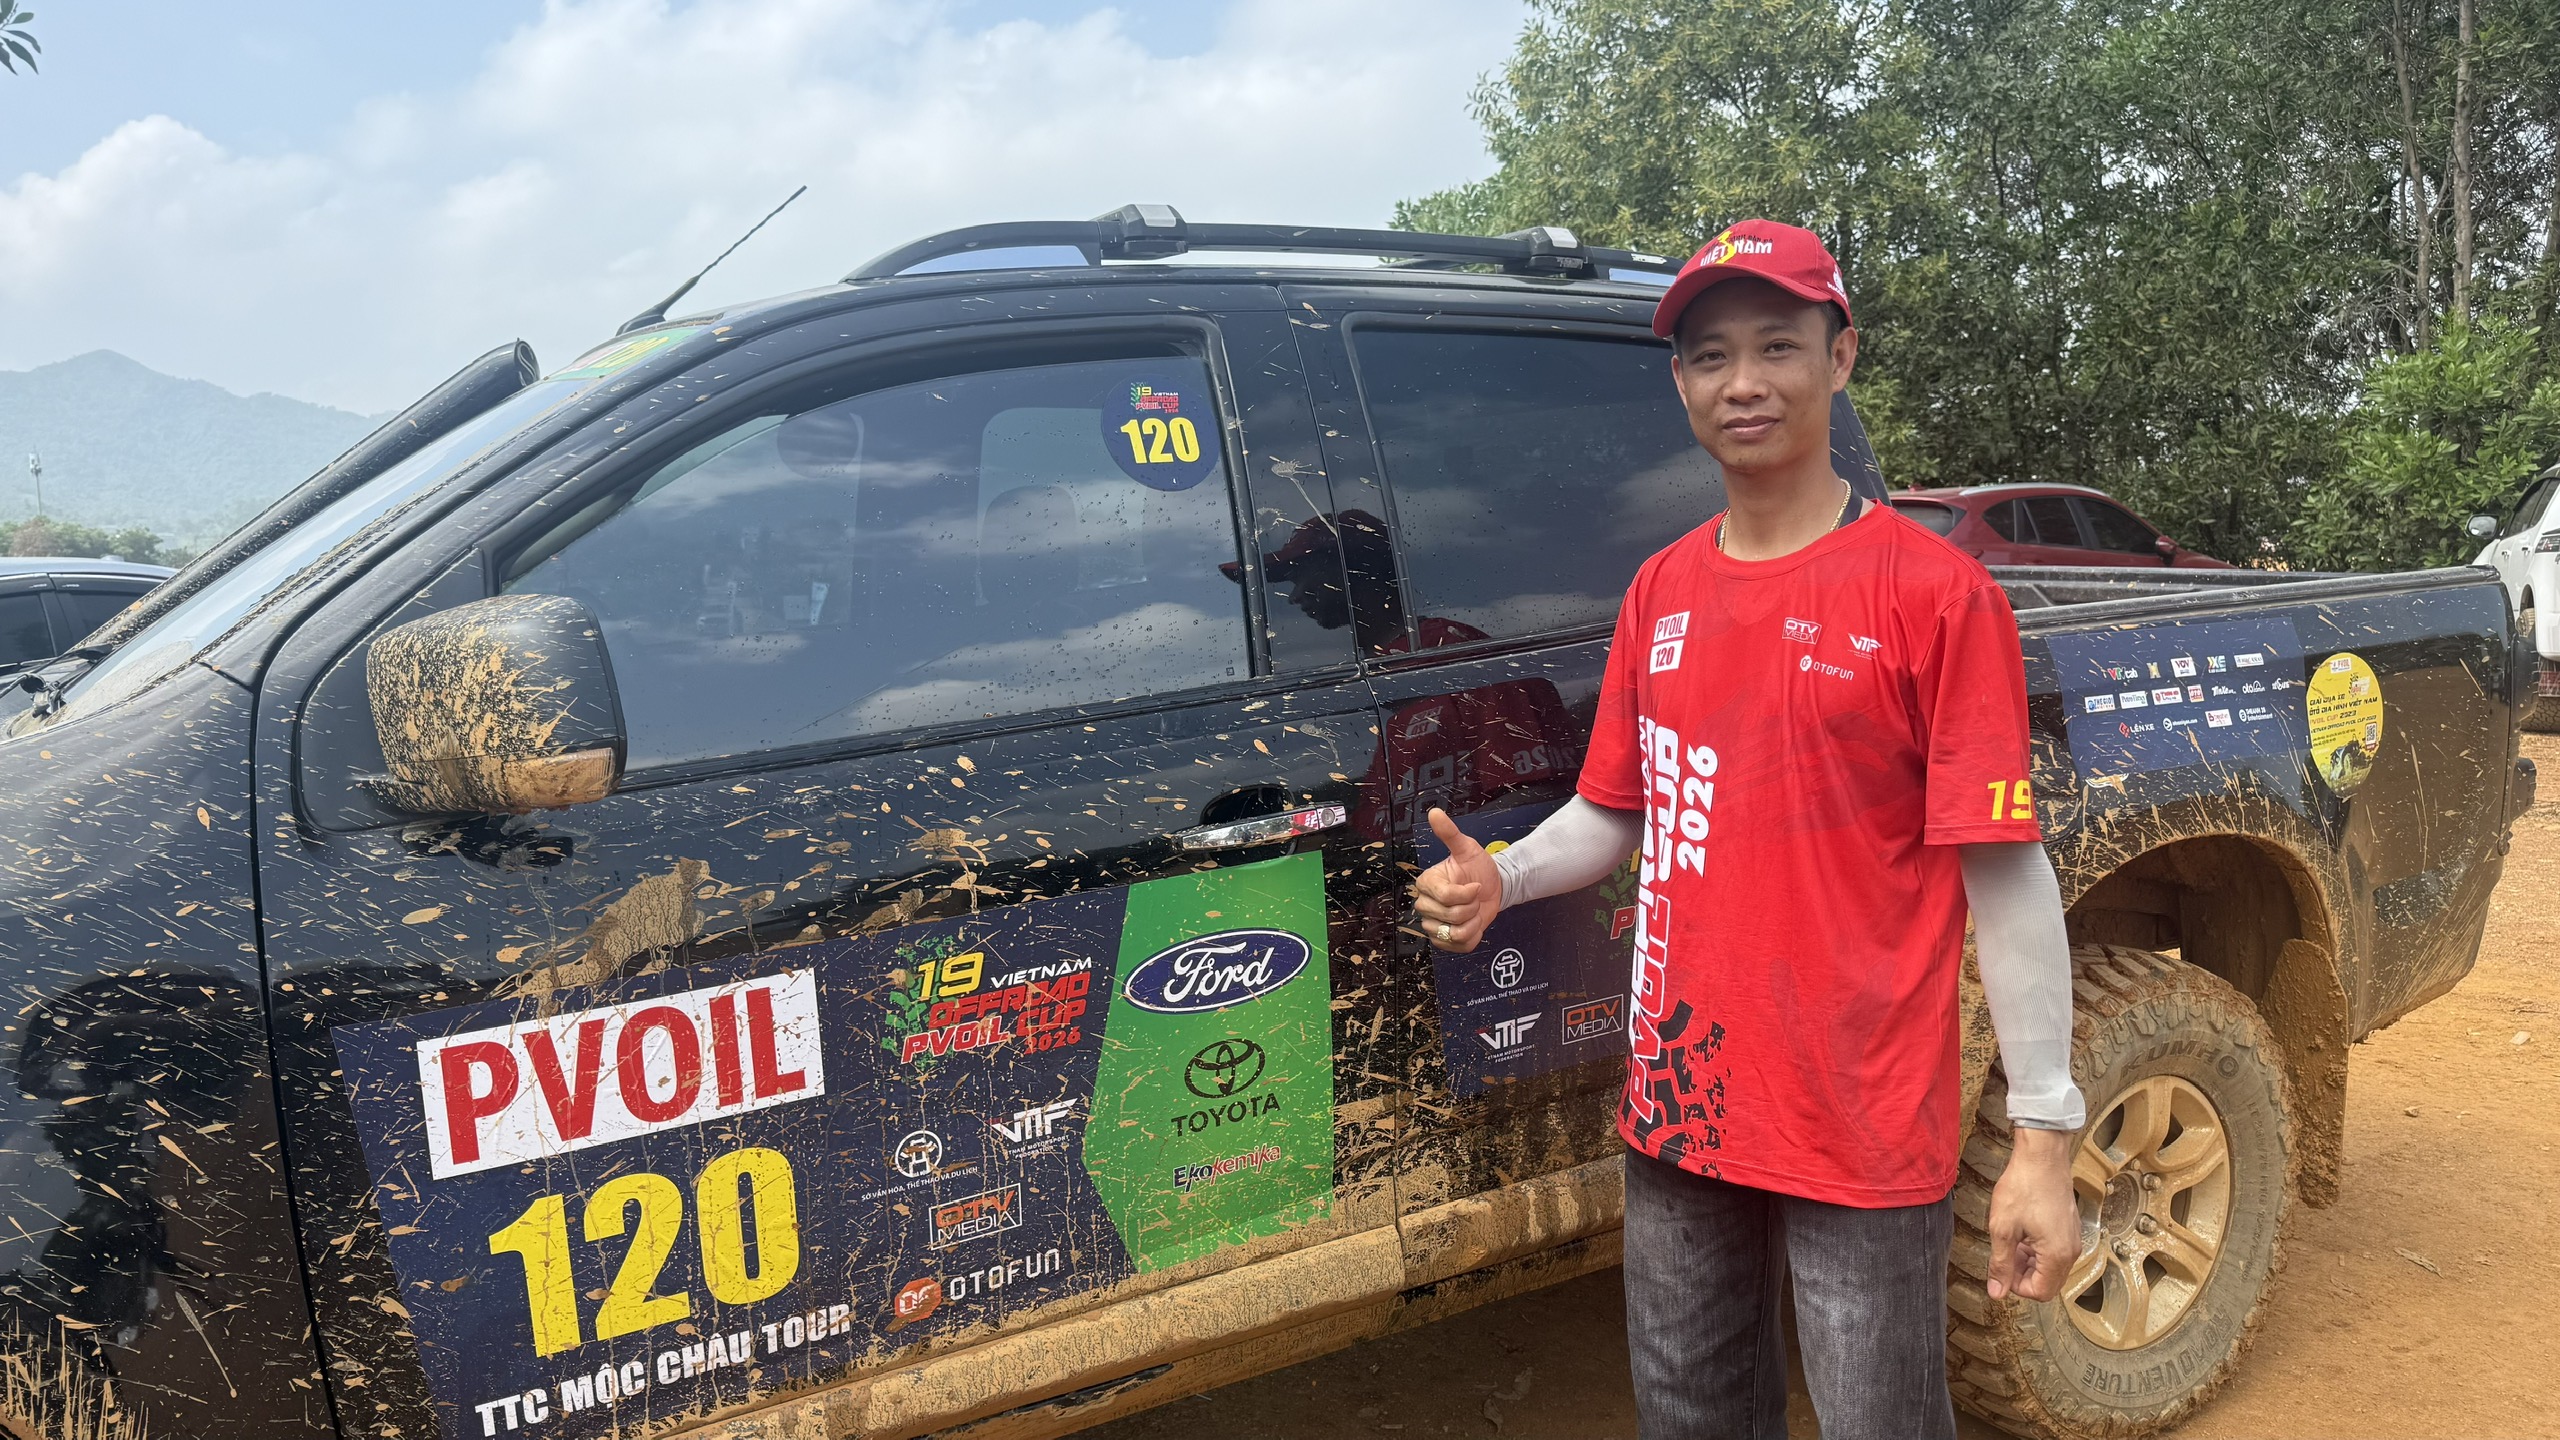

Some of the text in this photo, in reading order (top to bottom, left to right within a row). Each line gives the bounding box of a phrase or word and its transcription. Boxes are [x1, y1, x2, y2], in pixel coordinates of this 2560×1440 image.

[1734, 240, 1773, 255] NAM
[1137, 387, 1152, 396] 19
[1120, 417, 1200, 464] 120
[1656, 615, 1684, 640] PVOIL
[1785, 629, 1815, 644] MEDIA
[1655, 646, 1675, 668] 120
[1813, 661, 1854, 681] OTOFUN
[2175, 660, 2190, 669] VOV
[2364, 696, 2378, 704] NAM
[1655, 725, 1681, 883] CUP
[1676, 742, 1719, 878] 2026
[1987, 780, 2032, 820] 19
[918, 952, 1093, 1001] 19 VIETNAM
[1163, 941, 1276, 1003] Ford
[928, 971, 1091, 1030] OFFROAD
[1567, 1000, 1620, 1026] OTV
[1629, 894, 1670, 1124] PVOIL
[901, 999, 1087, 1065] PVOIL CUP
[1024, 1026, 1082, 1055] 2026
[1567, 1016, 1621, 1039] MEDIA
[440, 986, 807, 1166] PVOIL
[2121, 1039, 2240, 1079] KUMHO
[1171, 1092, 1282, 1137] TOYOTA
[1173, 1143, 1282, 1194] Ekokemika
[938, 1211, 1018, 1242] MEDIA
[488, 1147, 799, 1358] 120
[950, 1248, 1061, 1301] OTOFUN
[475, 1303, 850, 1437] TTC MỘC CHÂU TOUR
[2080, 1303, 2235, 1396] ROADVENTURE
